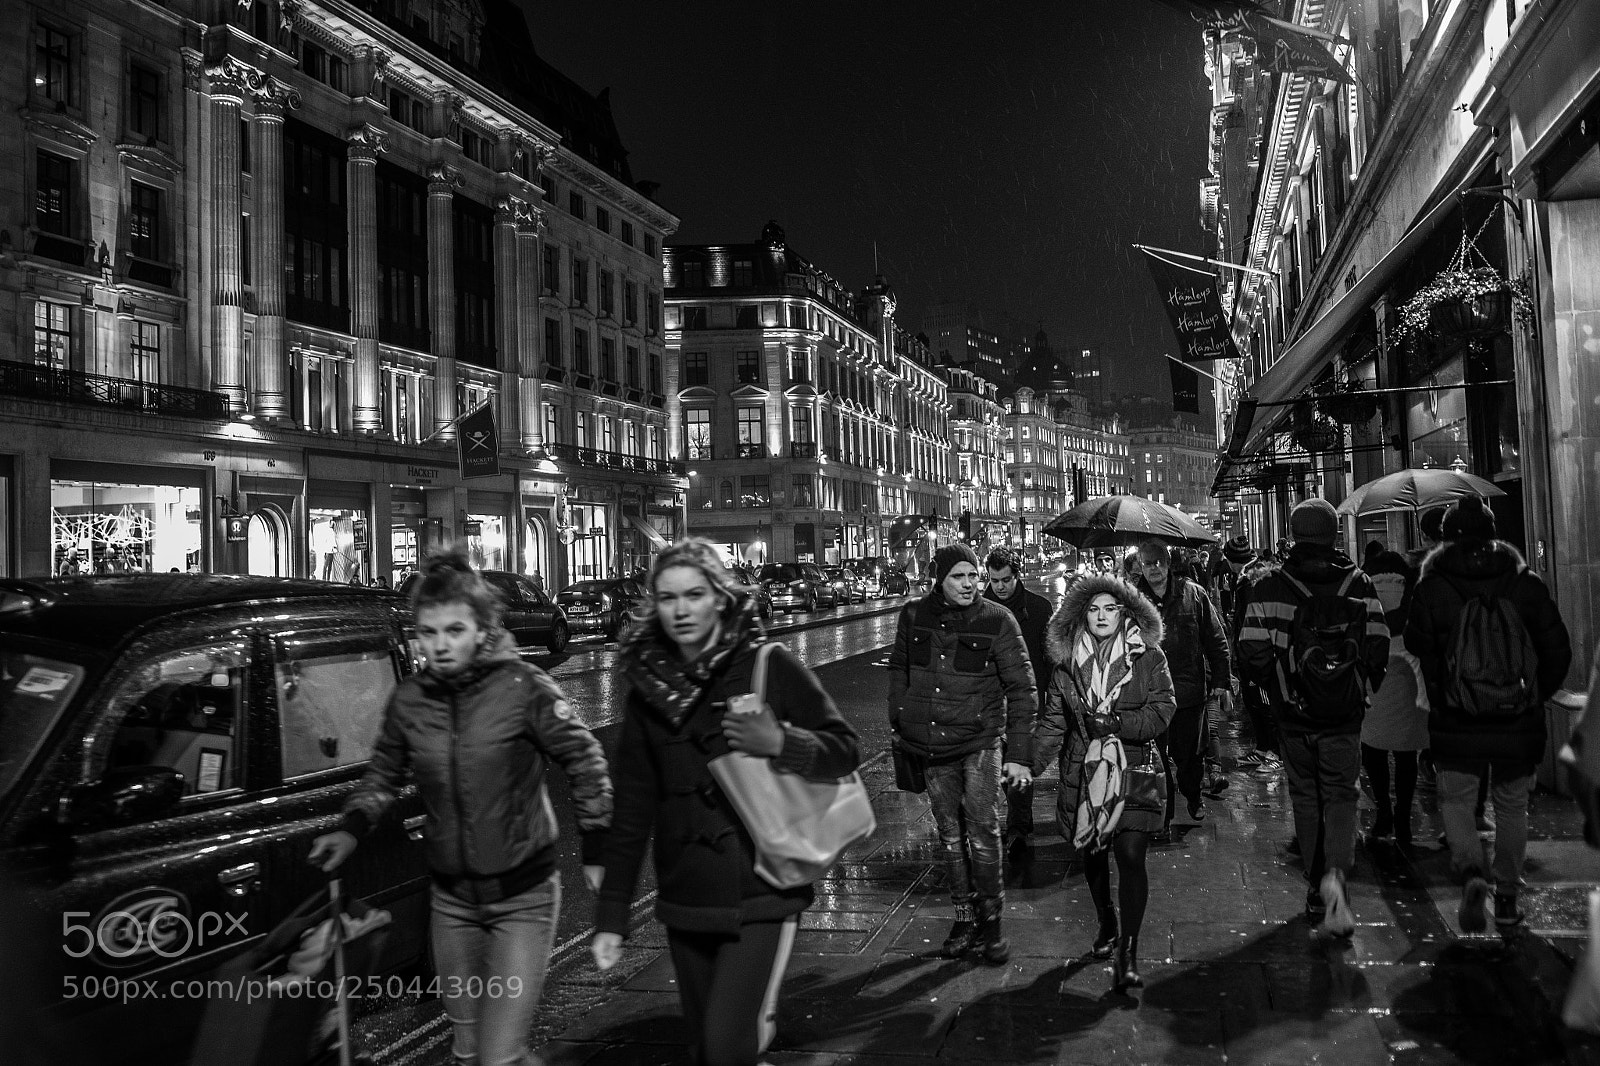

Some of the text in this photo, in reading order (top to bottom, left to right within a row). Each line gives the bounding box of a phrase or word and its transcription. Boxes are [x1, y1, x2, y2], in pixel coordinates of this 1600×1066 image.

[1168, 286, 1211, 306] Hamleys
[1177, 311, 1219, 333] Hamleys
[1187, 336, 1230, 356] Hamleys
[407, 465, 439, 478] HACKETT
